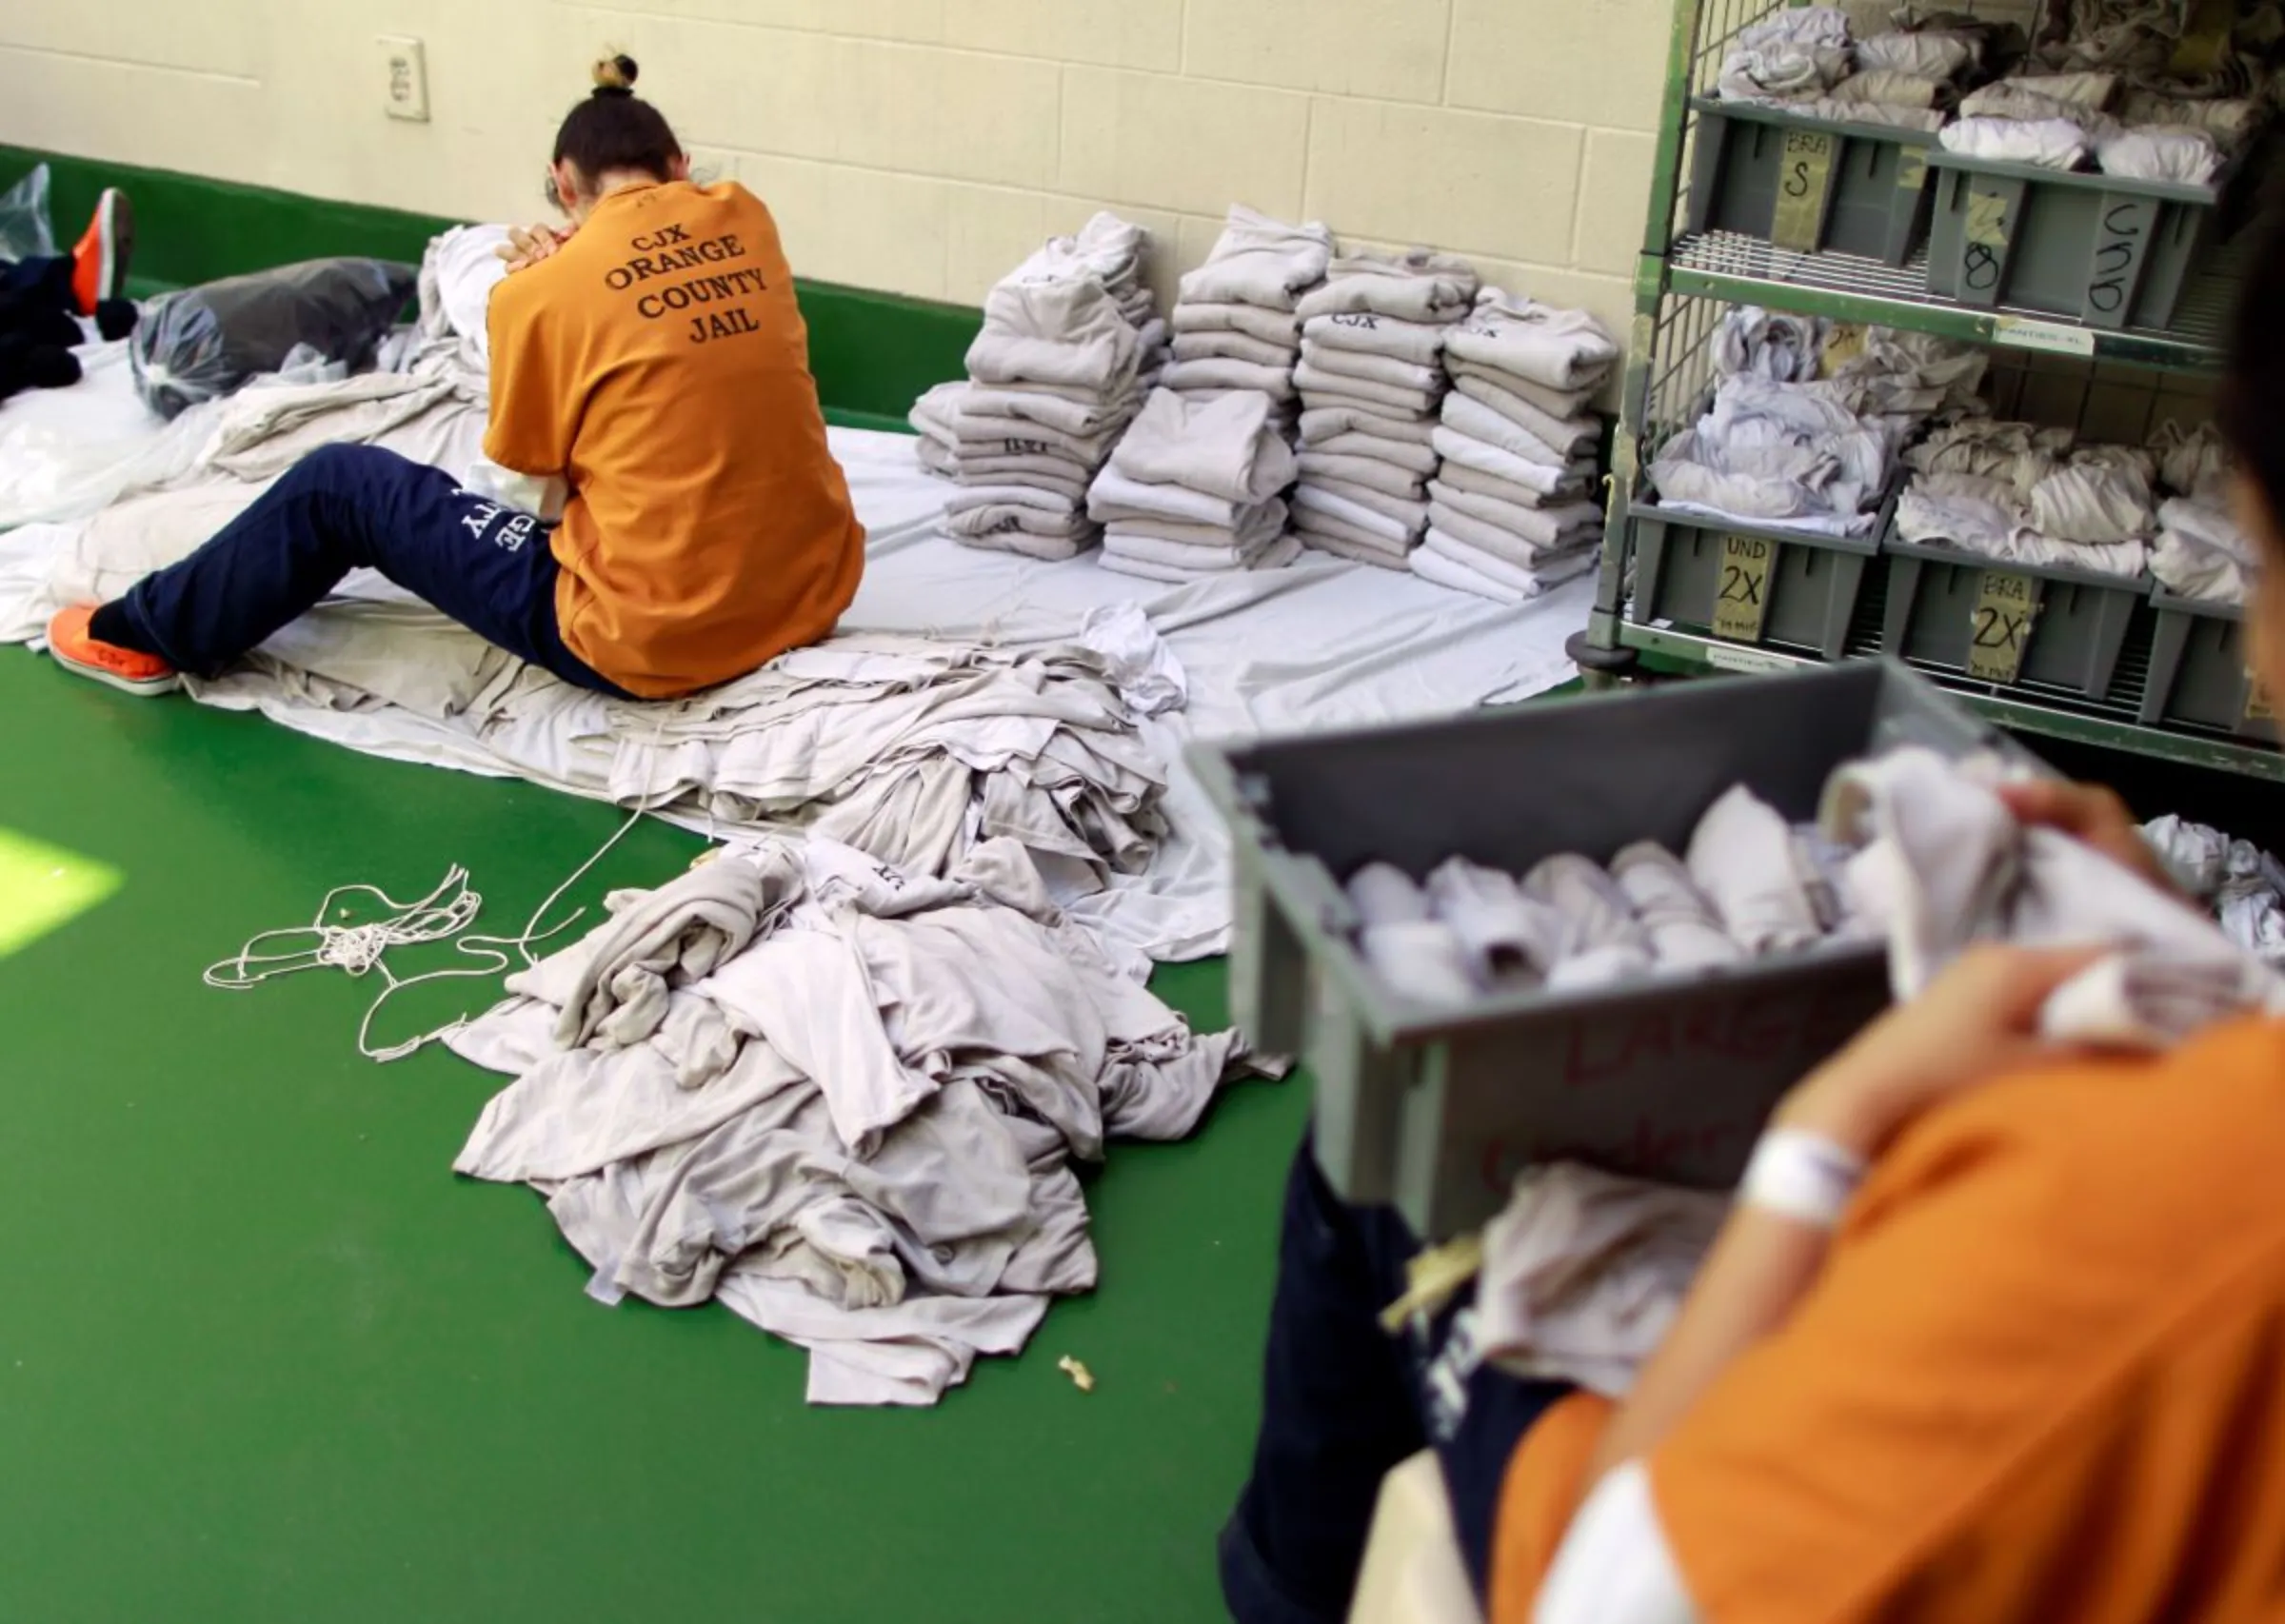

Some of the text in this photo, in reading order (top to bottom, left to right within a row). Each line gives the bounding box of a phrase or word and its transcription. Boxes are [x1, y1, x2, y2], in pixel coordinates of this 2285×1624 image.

[1786, 127, 1829, 156] BRA
[1783, 161, 1809, 197] S
[630, 223, 692, 252] CJX
[605, 234, 746, 290] ORANGE
[637, 267, 768, 319] COUNTY
[689, 307, 760, 344] JAIL
[1727, 537, 1766, 560] UND
[1719, 565, 1763, 606] 2X
[1983, 575, 2025, 602] BRA
[1972, 606, 2024, 652] 2X
